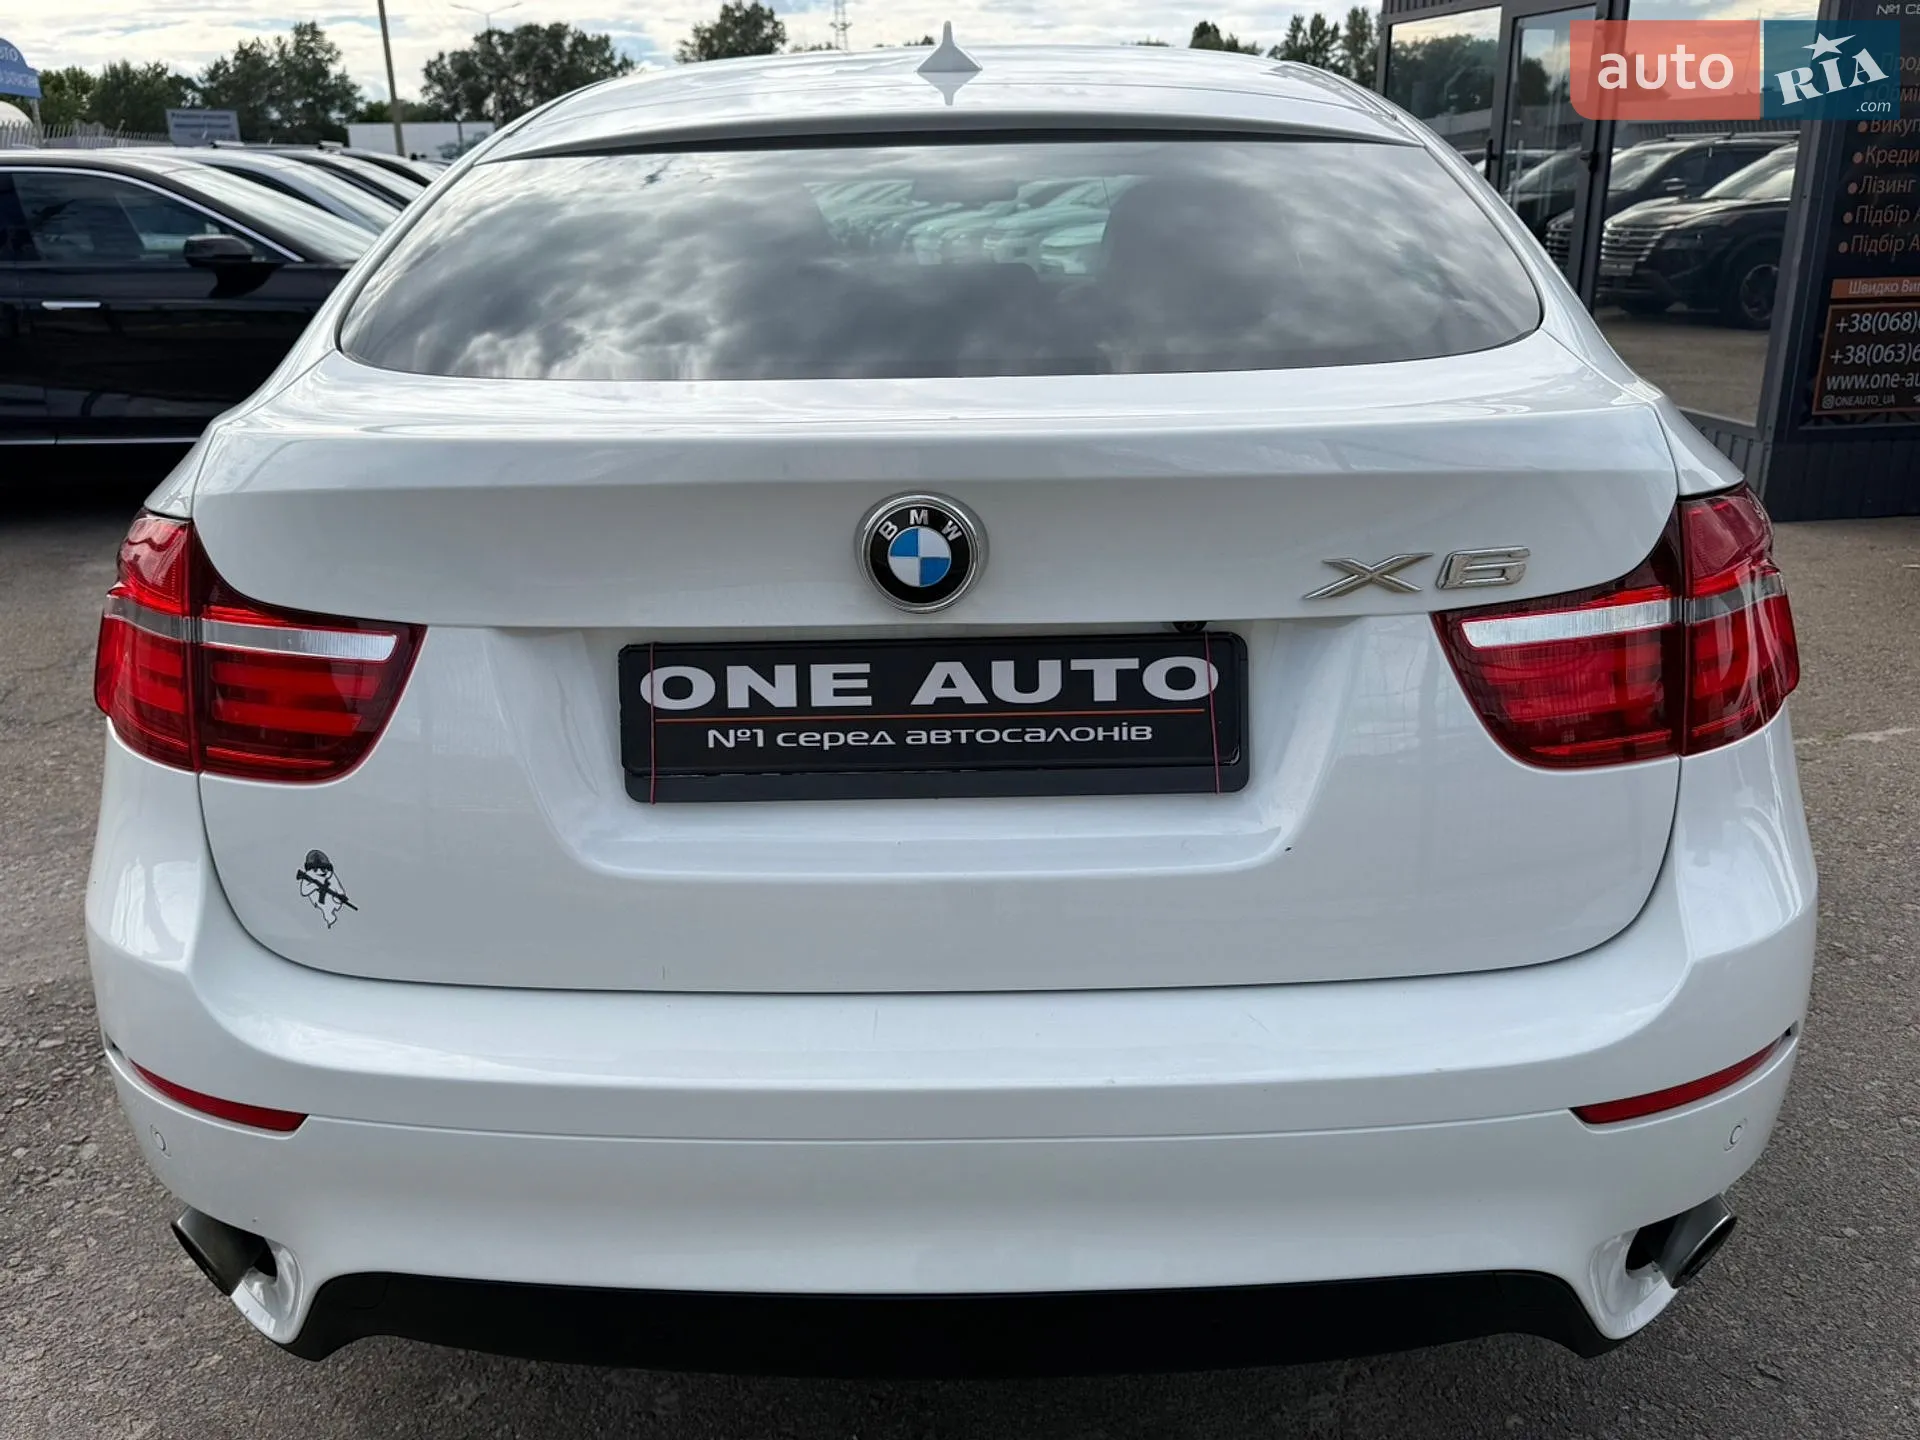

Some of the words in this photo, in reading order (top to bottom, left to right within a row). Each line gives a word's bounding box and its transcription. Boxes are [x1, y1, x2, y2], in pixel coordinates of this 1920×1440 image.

[1859, 175, 1916, 194] Лізинг
[1855, 204, 1910, 227] Підбір
[1850, 233, 1905, 257] Підбір
[1836, 311, 1920, 334] +38(068)
[879, 509, 962, 541] BMW
[640, 663, 872, 710] ONE
[910, 656, 1219, 705] AUTO
[776, 730, 896, 751] серед
[905, 722, 1153, 745] автосалонів
